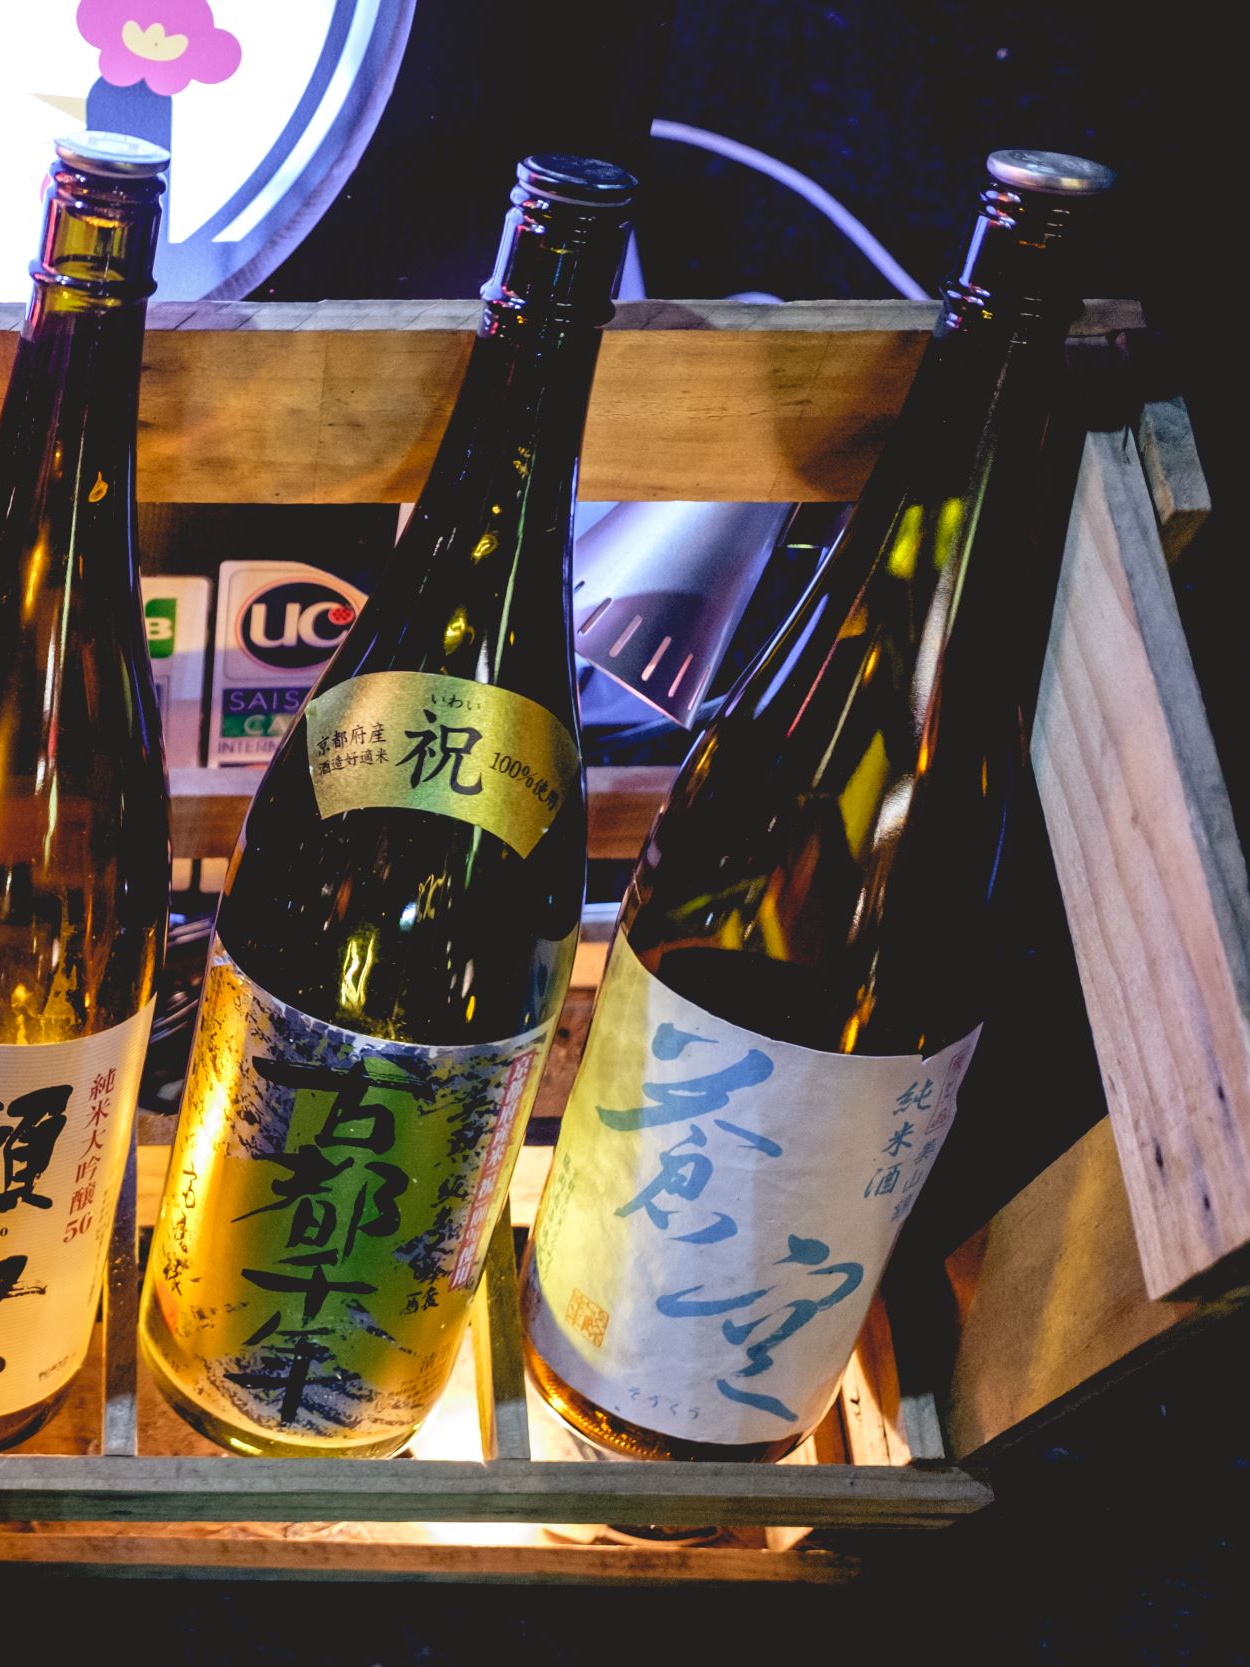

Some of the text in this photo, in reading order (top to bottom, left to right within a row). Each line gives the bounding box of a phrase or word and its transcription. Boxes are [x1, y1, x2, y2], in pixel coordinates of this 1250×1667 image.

[229, 690, 300, 712] SAIS
[430, 693, 481, 711] いわい
[243, 714, 288, 736] CA
[317, 721, 387, 756] 京都府産
[318, 747, 390, 776] 酒造好適米
[395, 709, 483, 796] 祝
[489, 751, 559, 811] 100%使用
[864, 1078, 934, 1198] 純米酒
